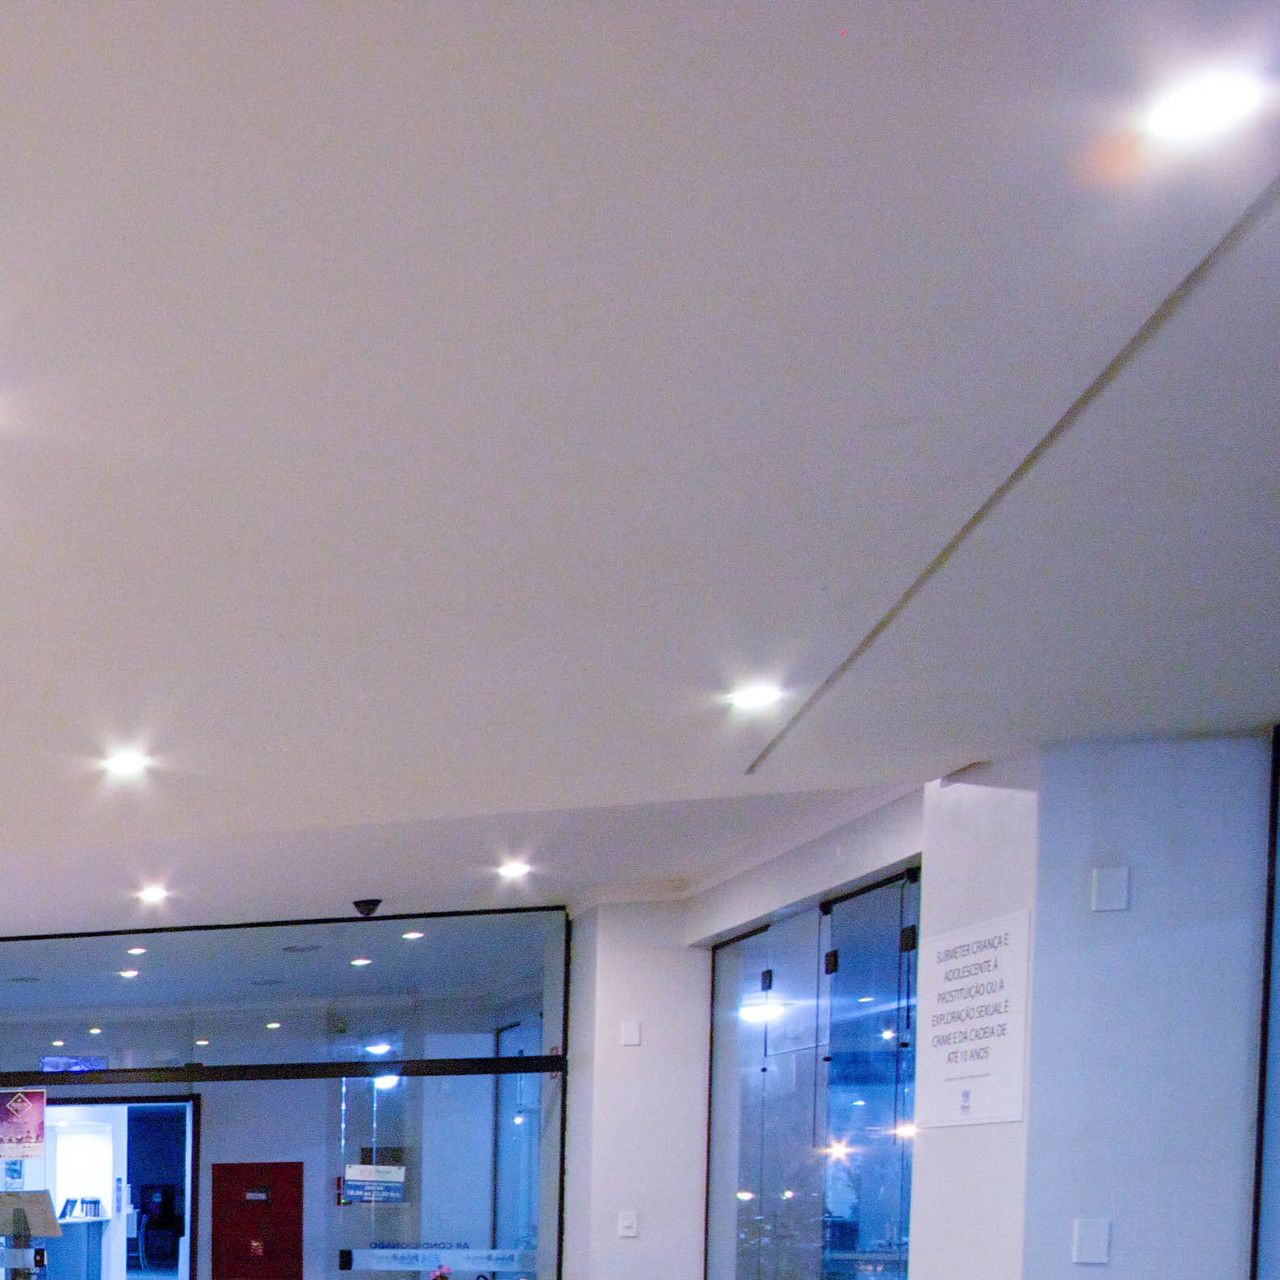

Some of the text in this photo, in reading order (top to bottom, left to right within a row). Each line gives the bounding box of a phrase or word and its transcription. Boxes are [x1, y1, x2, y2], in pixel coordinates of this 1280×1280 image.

[986, 980, 997, 995] OU
[976, 1002, 1003, 1018] SEXUAL
[931, 1032, 951, 1048] CRIME
[969, 1026, 996, 1042] CADEIA
[997, 1022, 1008, 1038] DE
[969, 1045, 990, 1061] ANOS
